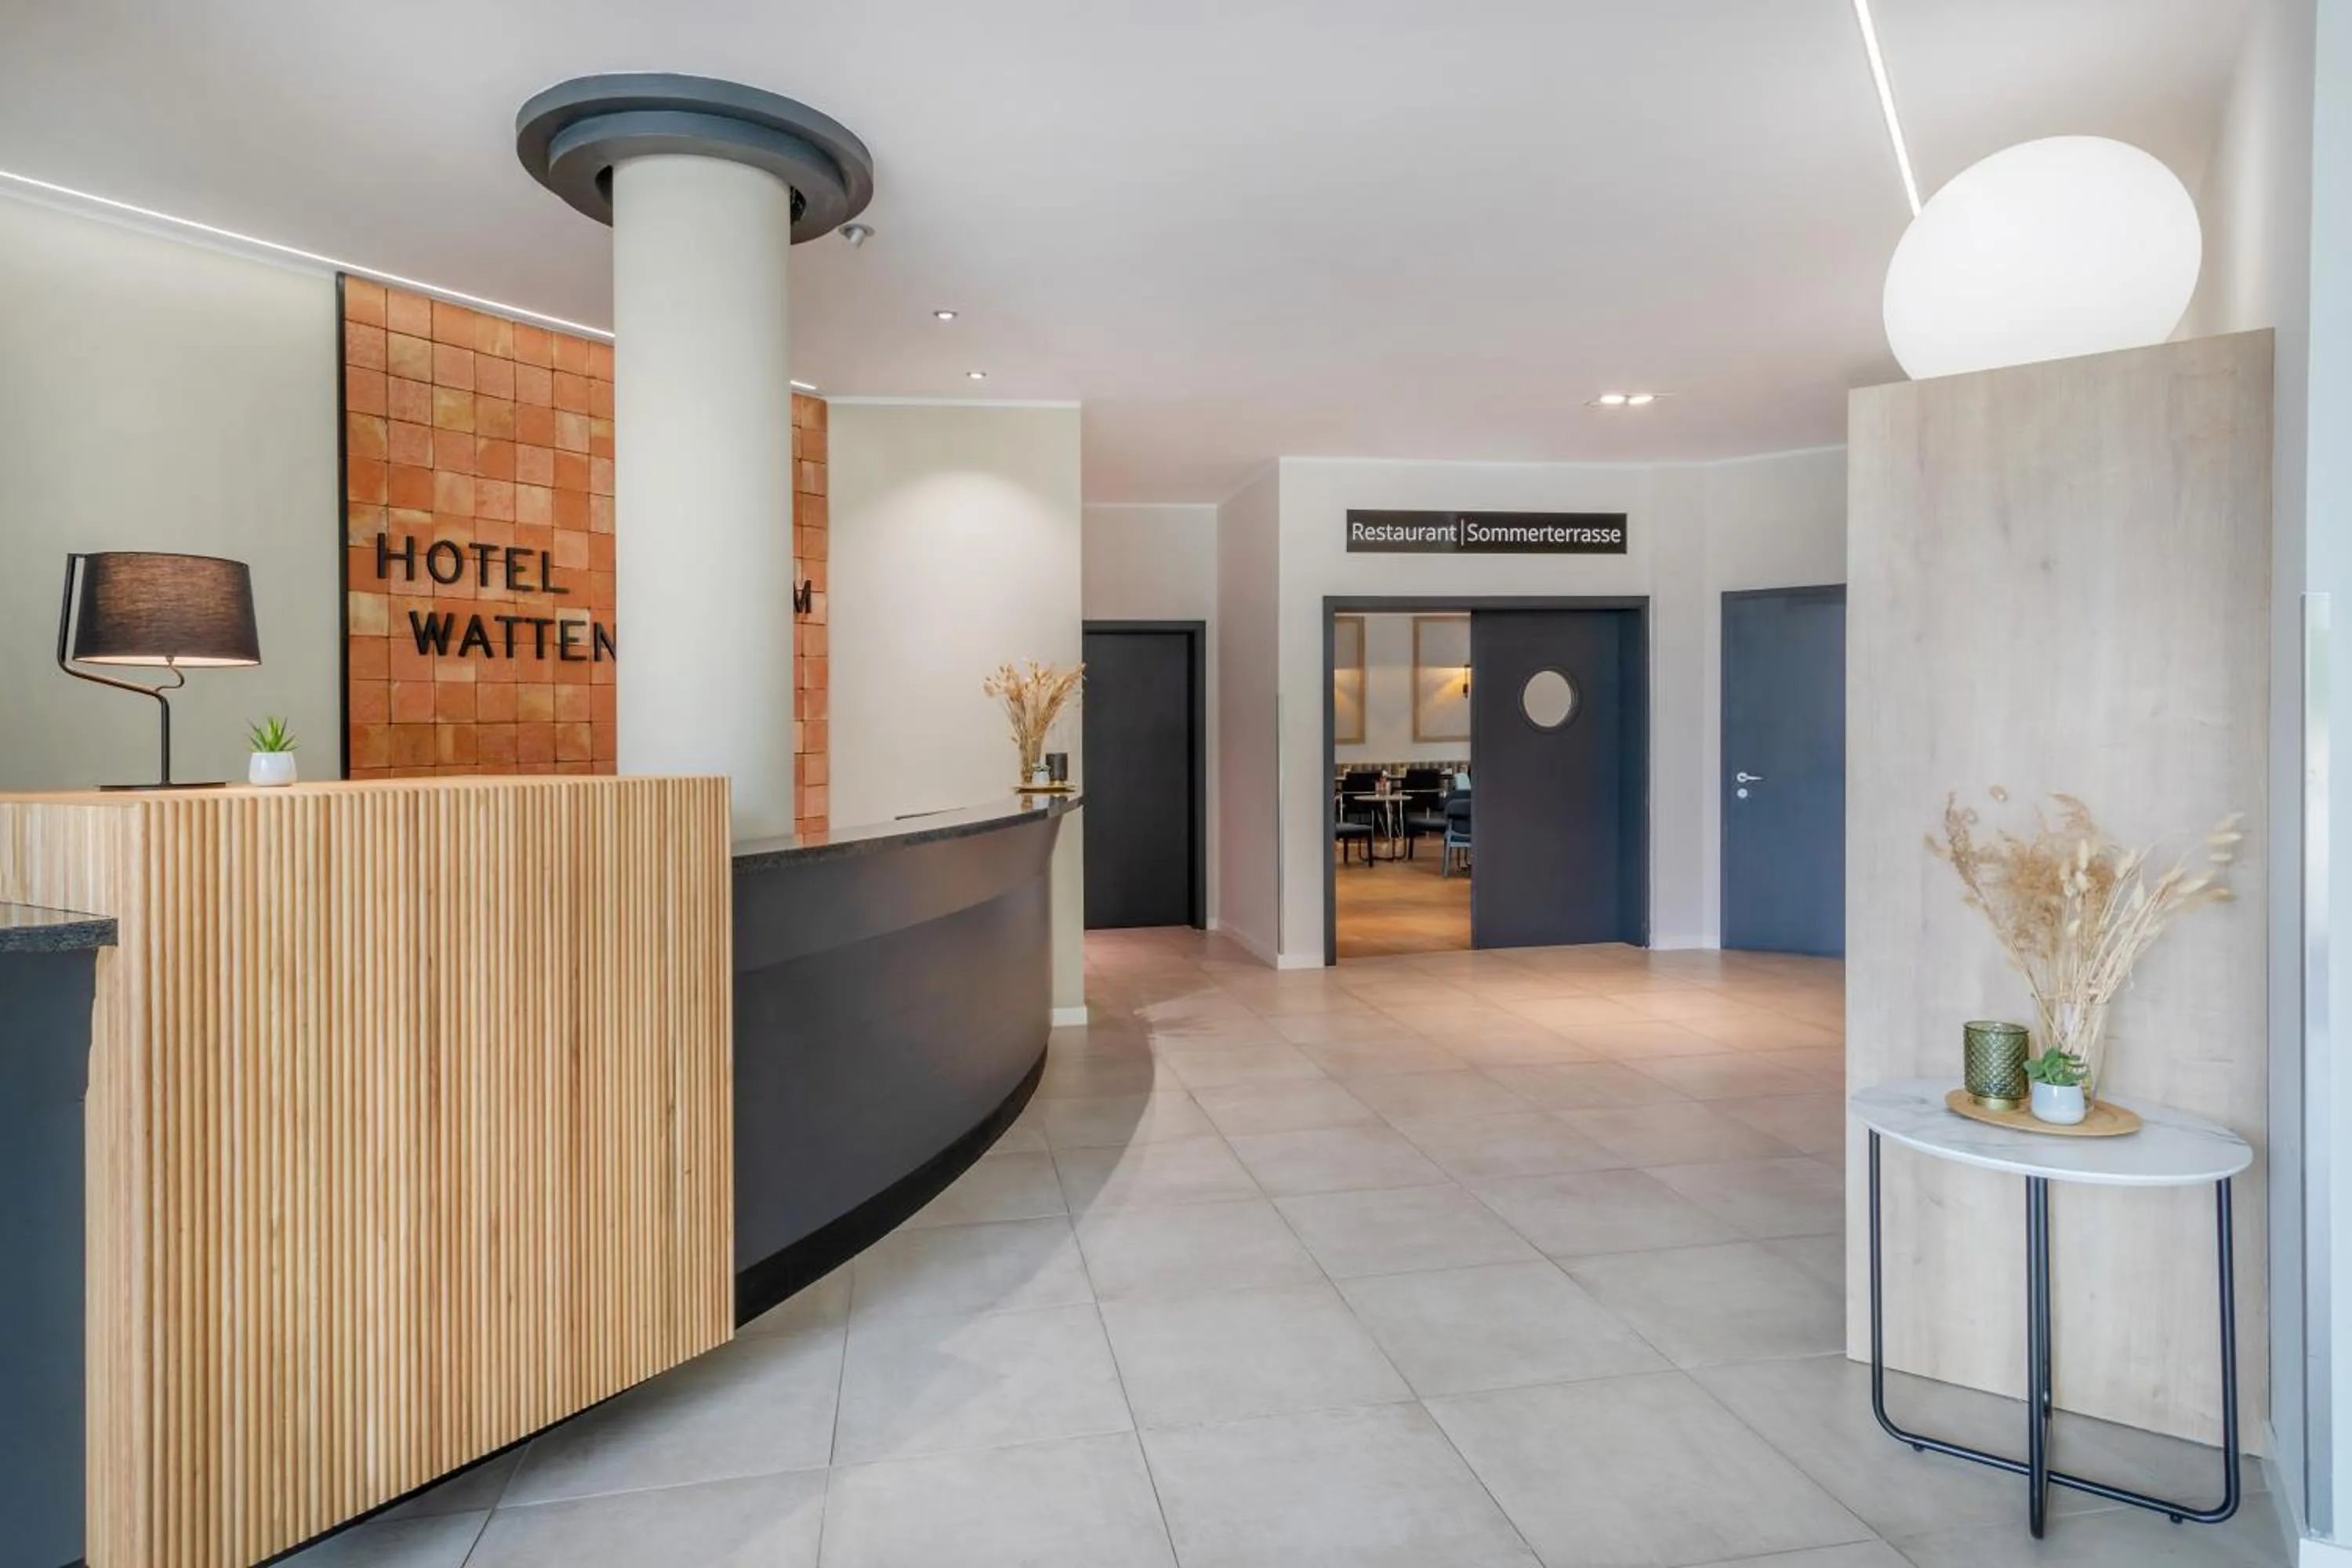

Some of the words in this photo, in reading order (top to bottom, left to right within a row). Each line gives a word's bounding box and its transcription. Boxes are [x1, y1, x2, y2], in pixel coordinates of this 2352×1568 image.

[1352, 522, 1457, 541] Restaurant
[1467, 523, 1621, 543] Sommerterrasse
[377, 532, 570, 594] HOTEL
[408, 610, 616, 662] WATTEN
